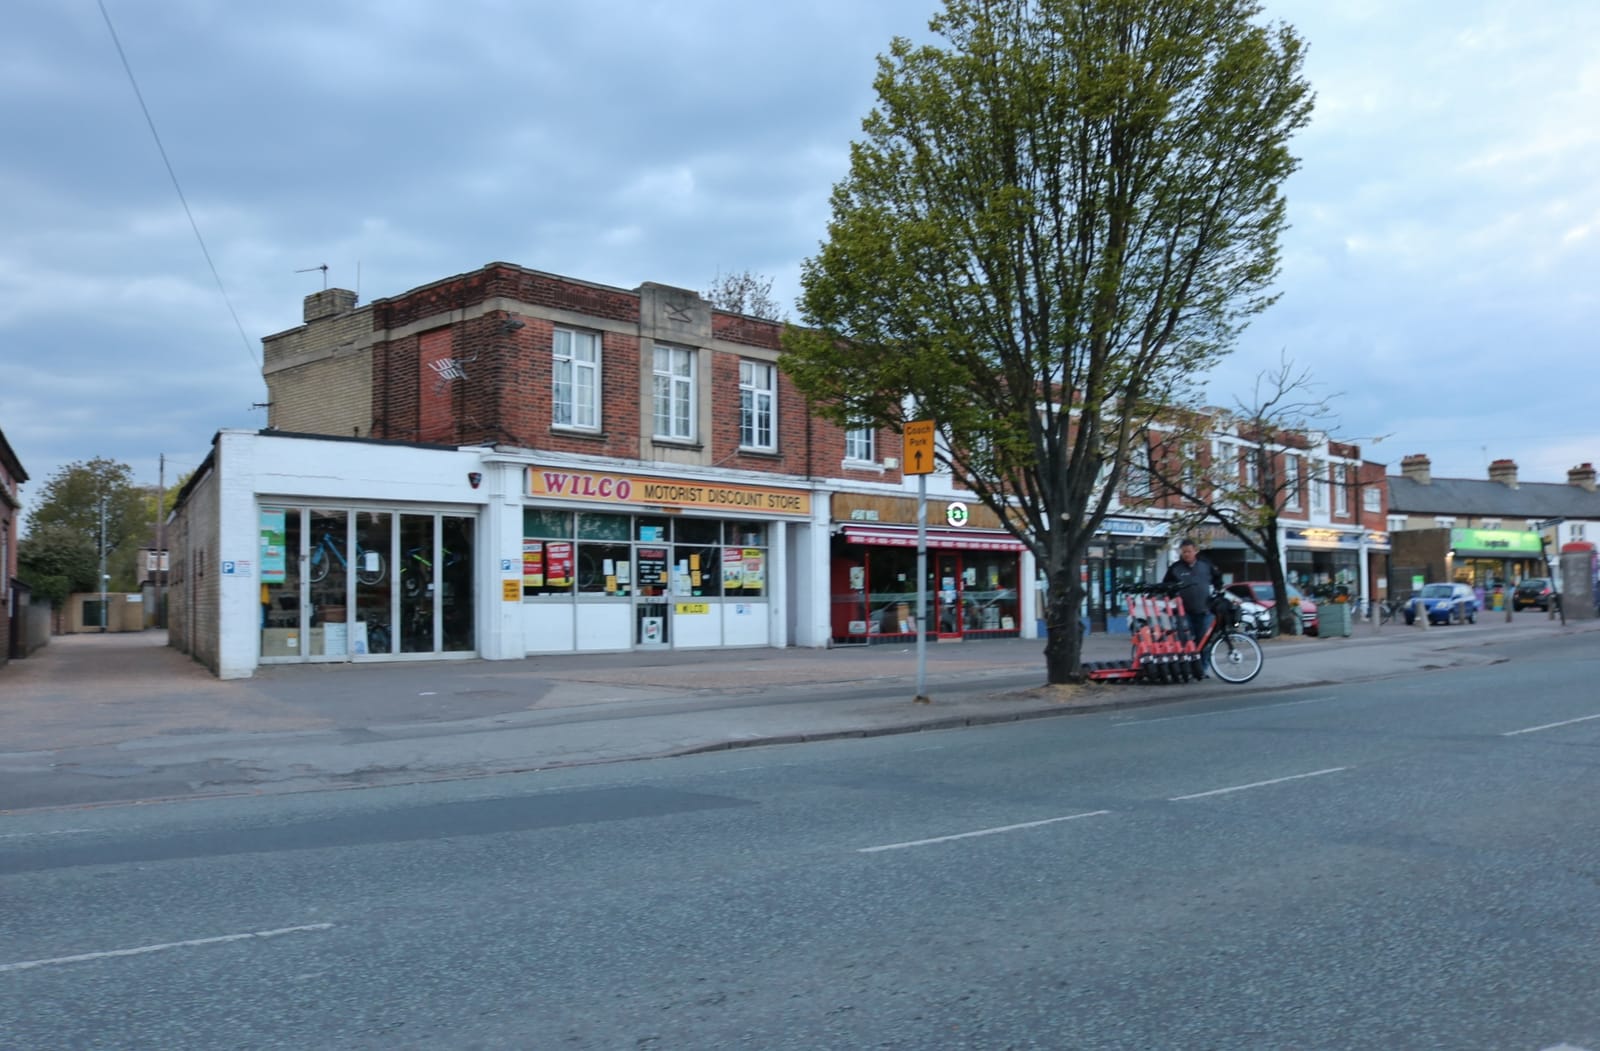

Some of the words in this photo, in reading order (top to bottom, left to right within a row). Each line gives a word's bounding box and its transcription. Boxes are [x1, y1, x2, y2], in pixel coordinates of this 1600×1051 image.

[906, 425, 931, 436] Coach
[909, 438, 927, 447] Park
[543, 472, 631, 500] WILCO
[644, 484, 703, 502] MOTORIST
[708, 488, 763, 506] DISCOUNT
[768, 493, 801, 510] STORE
